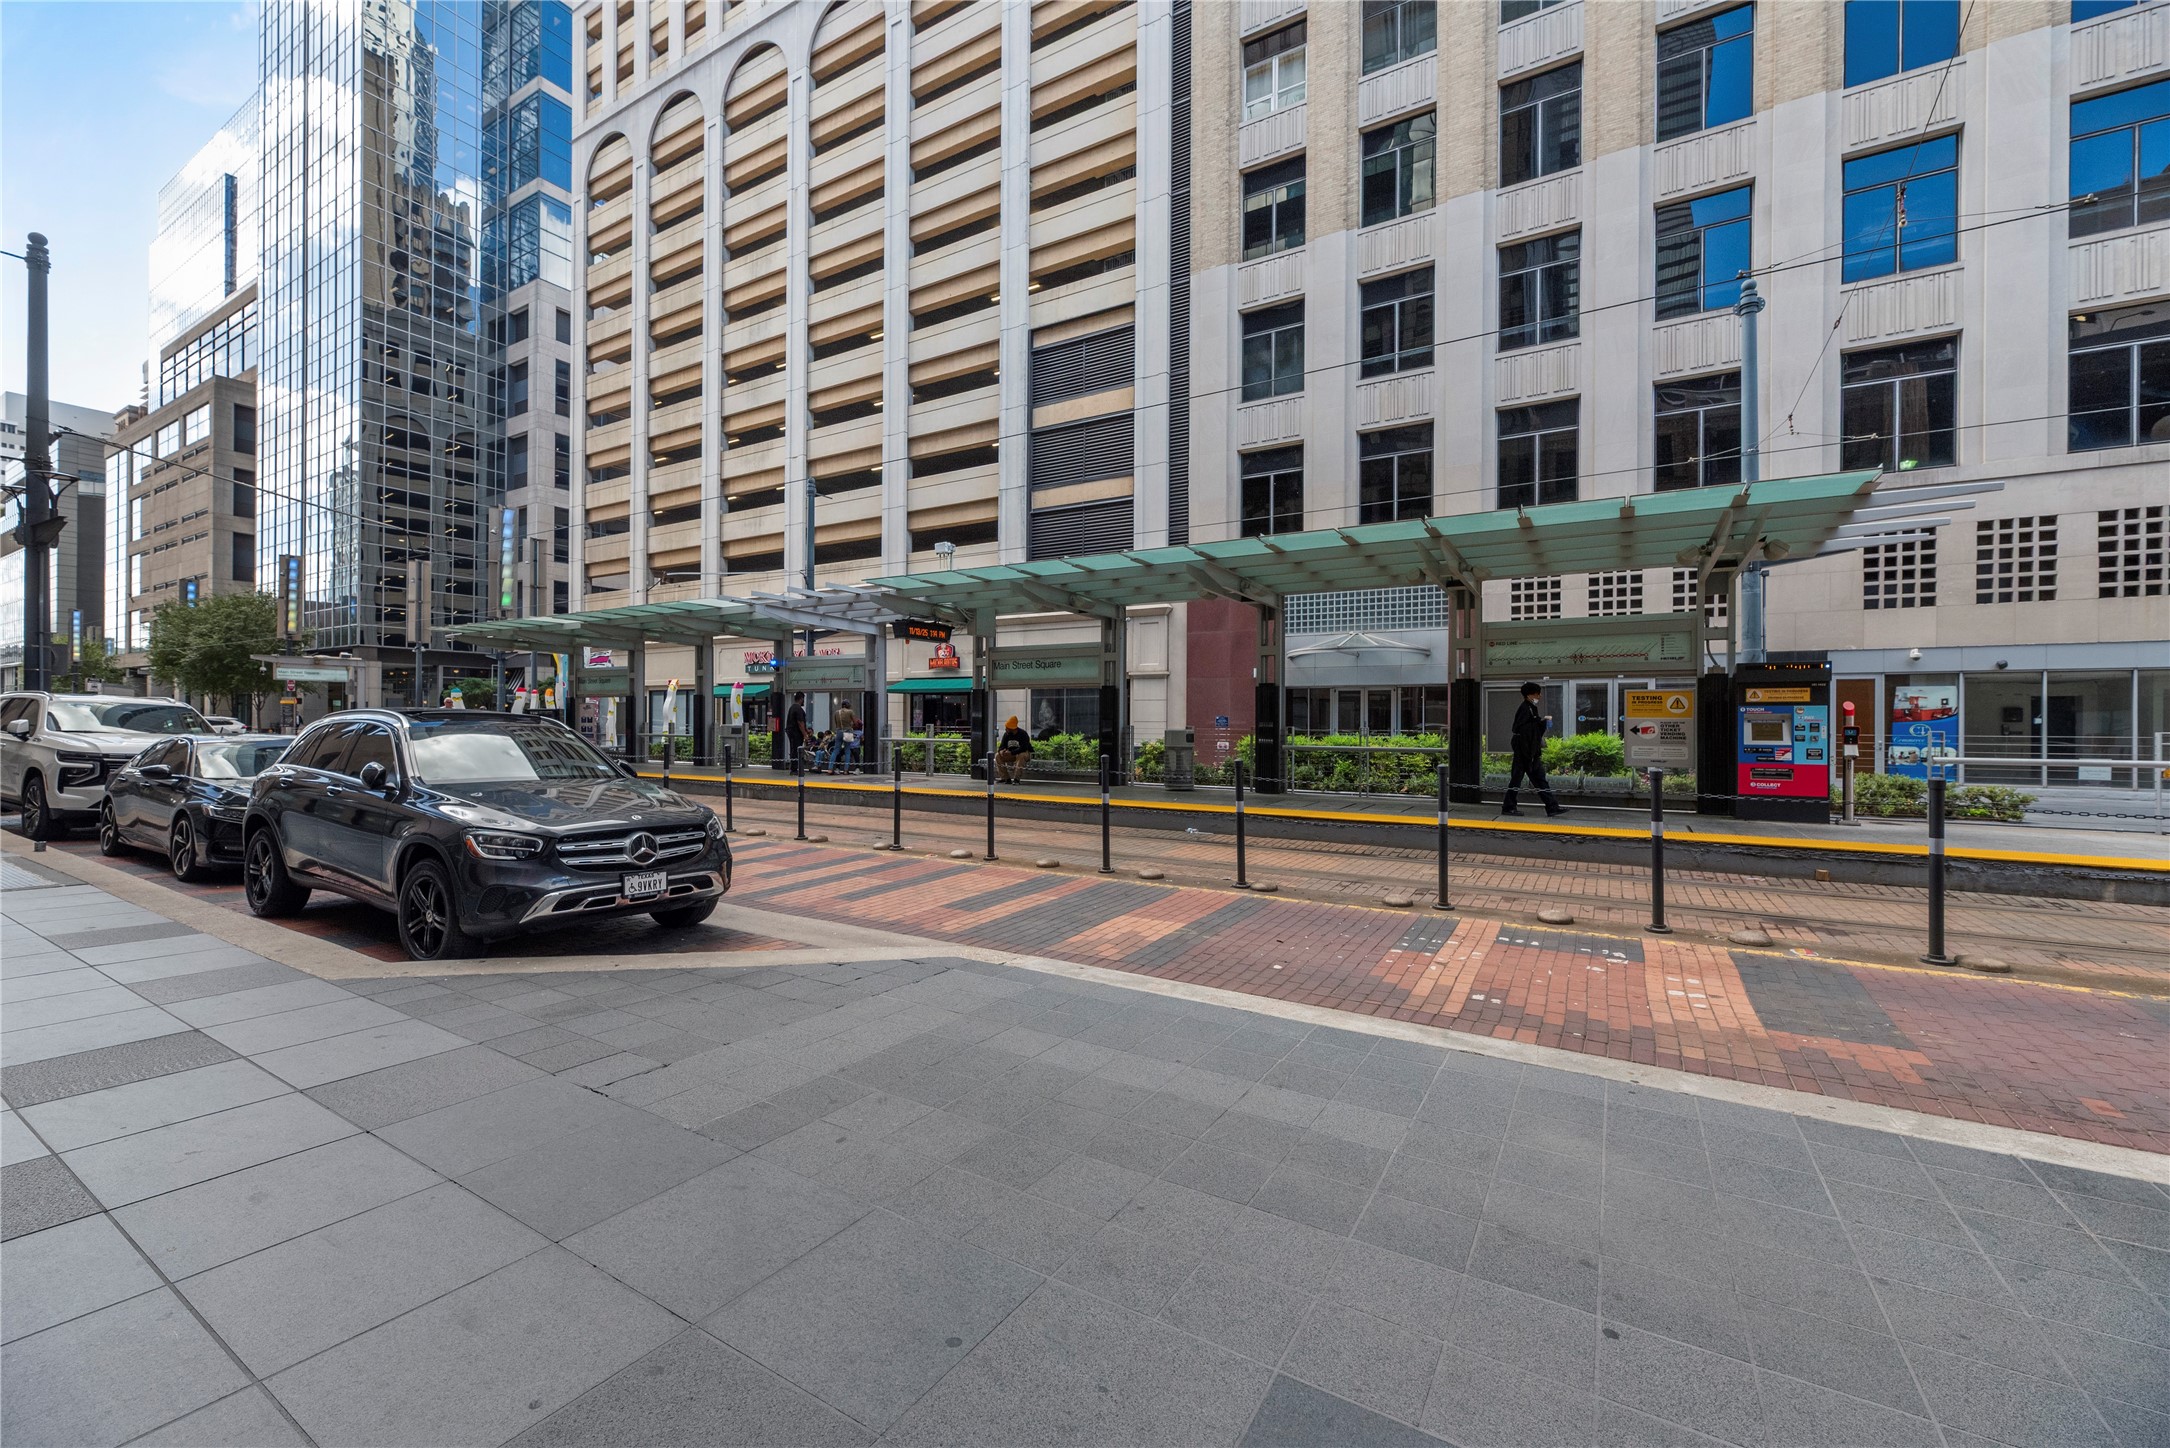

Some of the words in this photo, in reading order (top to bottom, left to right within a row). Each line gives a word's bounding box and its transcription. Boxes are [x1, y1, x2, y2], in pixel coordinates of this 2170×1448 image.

[994, 662, 1010, 671] Main
[1012, 661, 1033, 670] Street
[1035, 660, 1062, 670] Square
